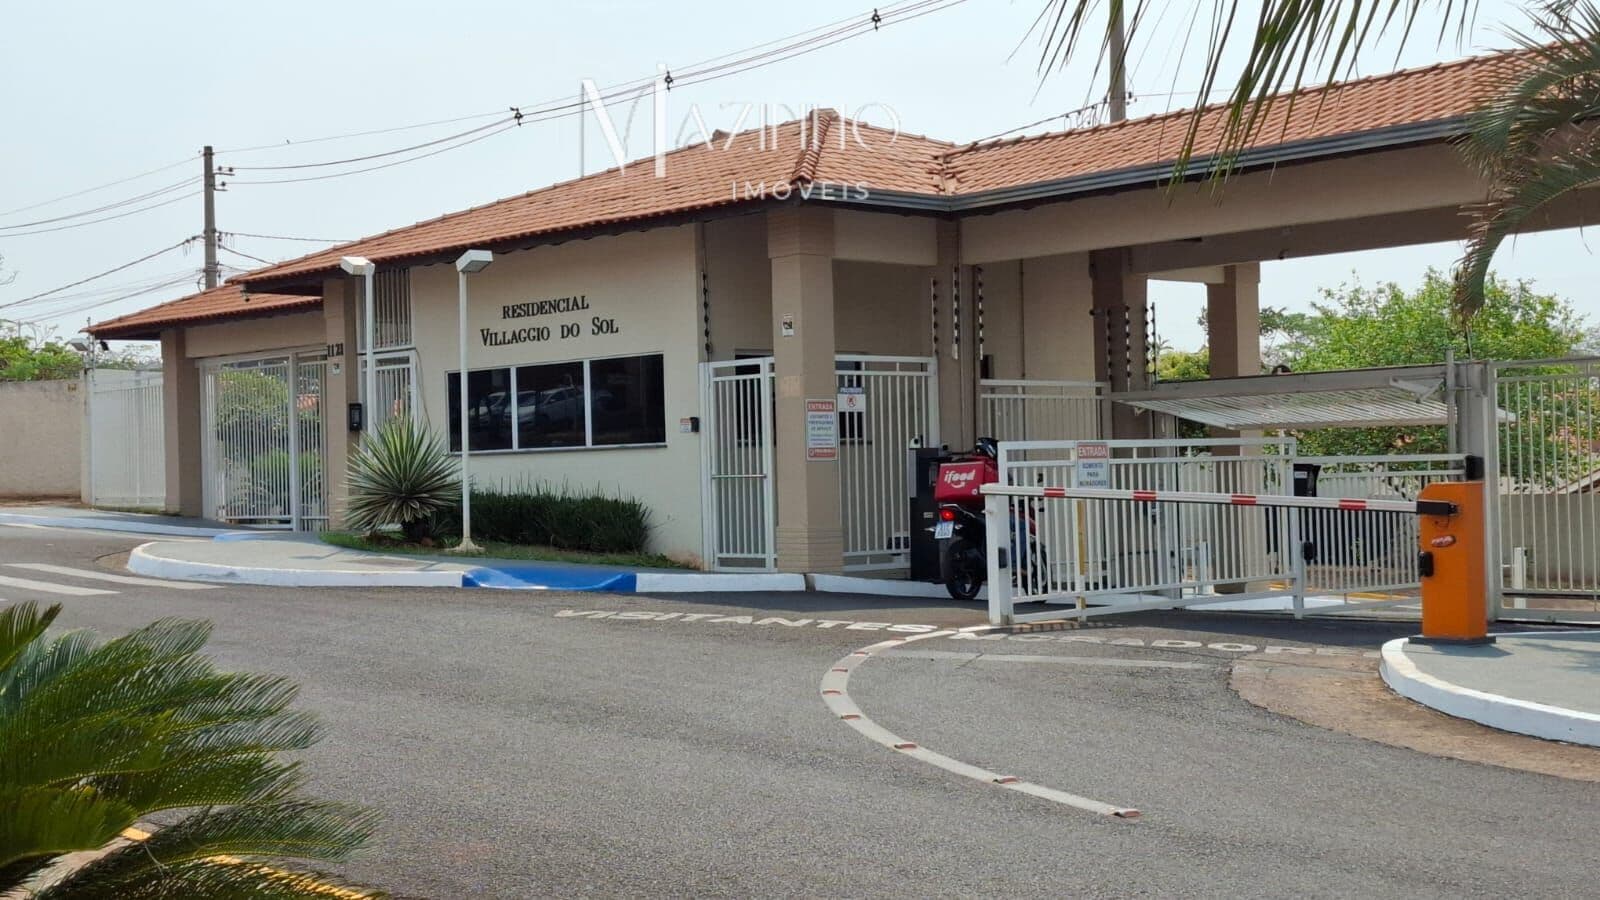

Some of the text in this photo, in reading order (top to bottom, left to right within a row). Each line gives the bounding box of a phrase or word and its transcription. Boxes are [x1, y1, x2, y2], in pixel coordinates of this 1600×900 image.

[502, 295, 590, 320] RESIDENCIAL
[1078, 446, 1107, 457] ENTRADA
[554, 608, 937, 634] VISITANTES
